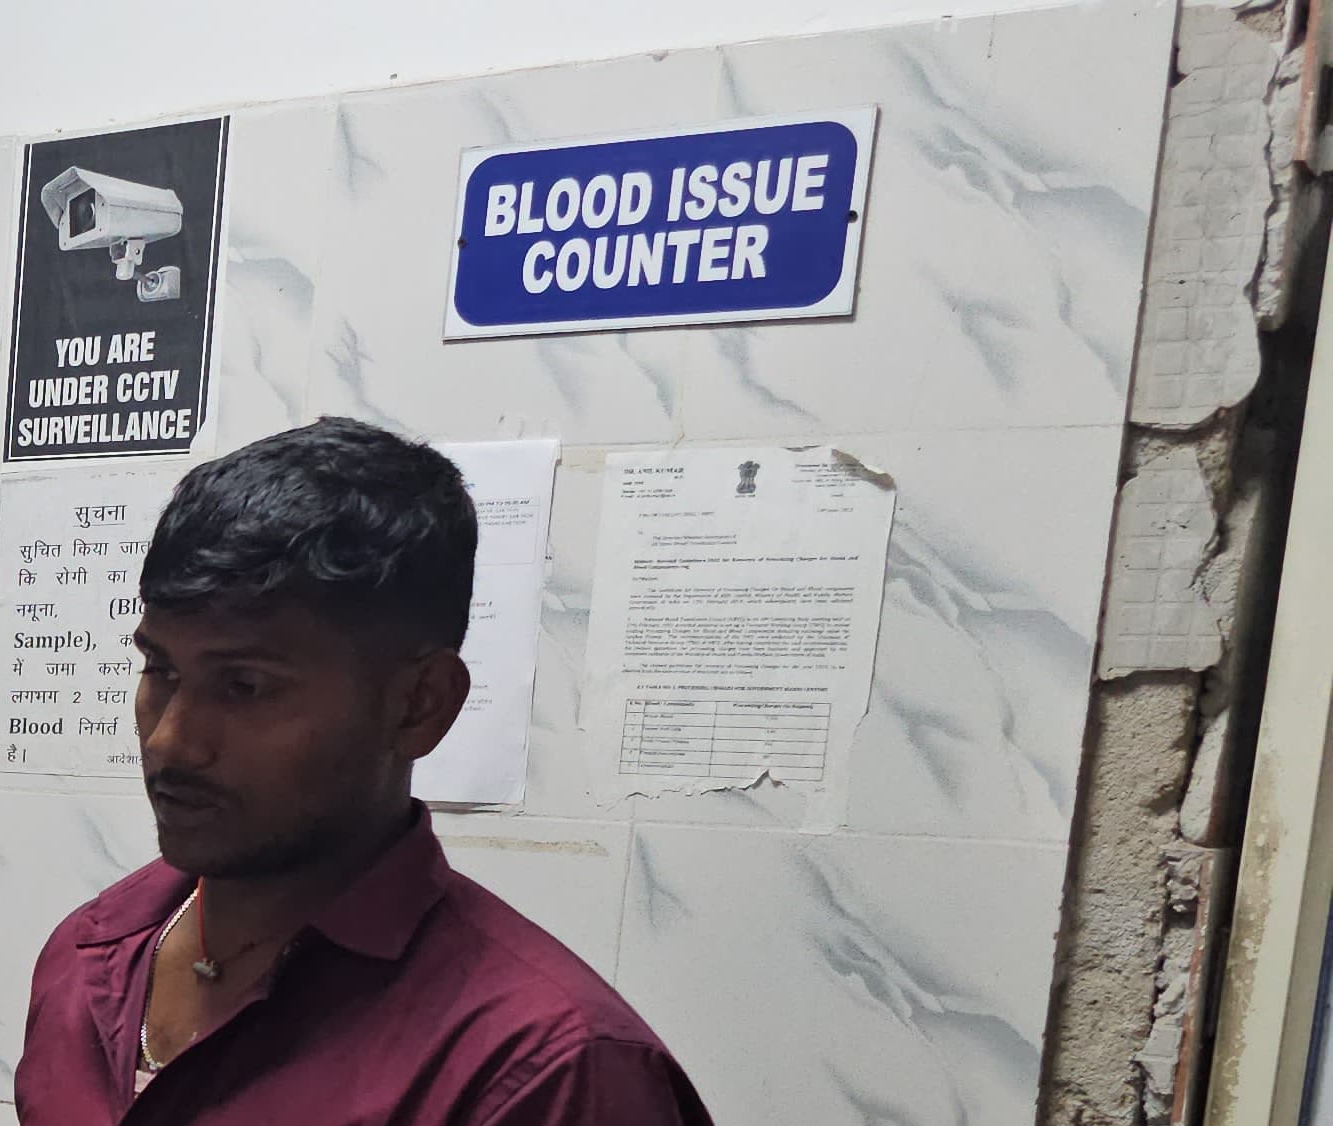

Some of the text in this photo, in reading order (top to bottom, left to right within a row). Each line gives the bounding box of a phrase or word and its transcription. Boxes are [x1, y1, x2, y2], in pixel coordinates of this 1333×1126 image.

[484, 154, 829, 237] BLOOD ISSUE
[522, 224, 769, 294] COUNTER
[55, 331, 156, 368] YOU ARE
[29, 370, 180, 408] UNDER CCTV
[17, 408, 192, 447] SURVEILLANCE
[73, 504, 127, 528] सुचना
[19, 538, 151, 563] सुचित किया जात
[18, 566, 127, 586] कि रोगी का
[13, 631, 97, 652] Sample),
[12, 657, 133, 676] में जमा करने
[10, 687, 127, 704] लगभग 2 घंटा
[9, 718, 63, 735] Blood
